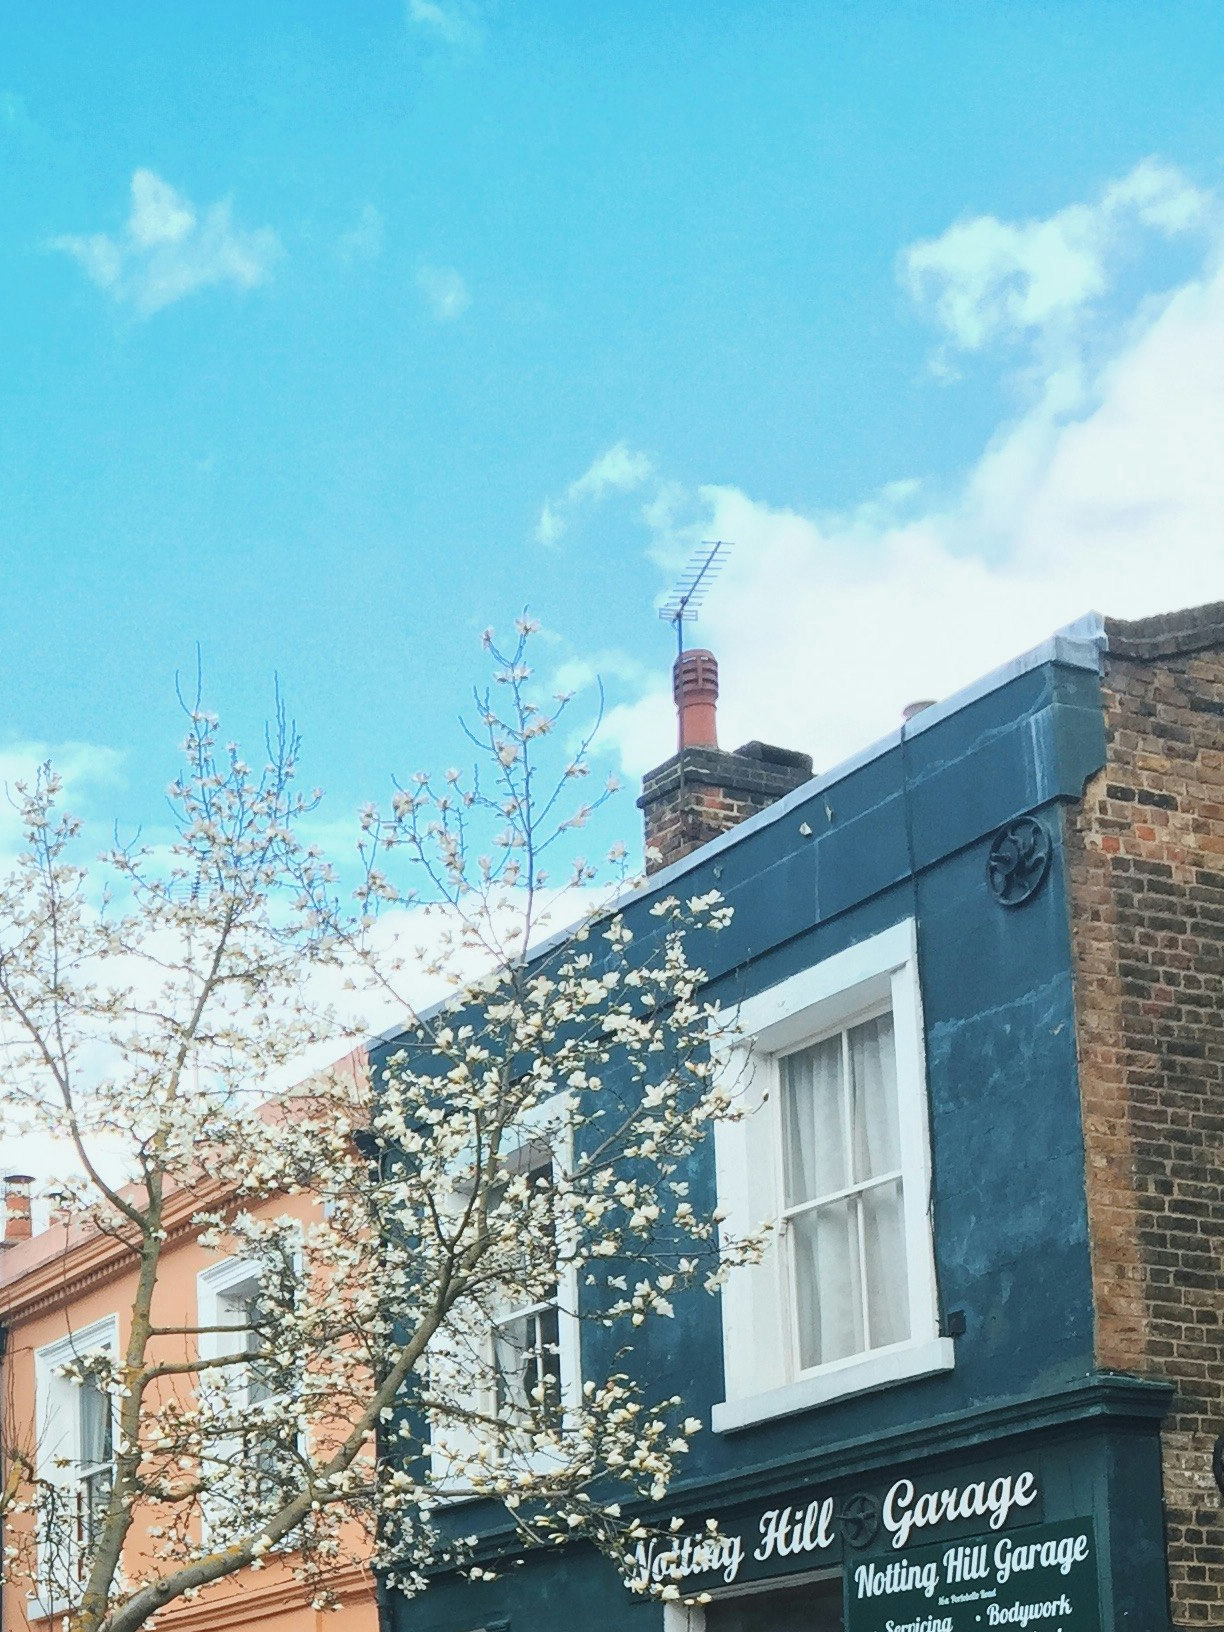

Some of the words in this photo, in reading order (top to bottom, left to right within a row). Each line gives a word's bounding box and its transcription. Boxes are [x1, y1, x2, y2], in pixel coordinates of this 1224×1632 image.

[754, 1496, 836, 1561] Hill
[882, 1471, 1038, 1549] Garage
[854, 1558, 940, 1599] Notting
[942, 1542, 990, 1584] Hill
[993, 1534, 1090, 1584] Garage
[986, 1593, 1073, 1628] Bodywork
